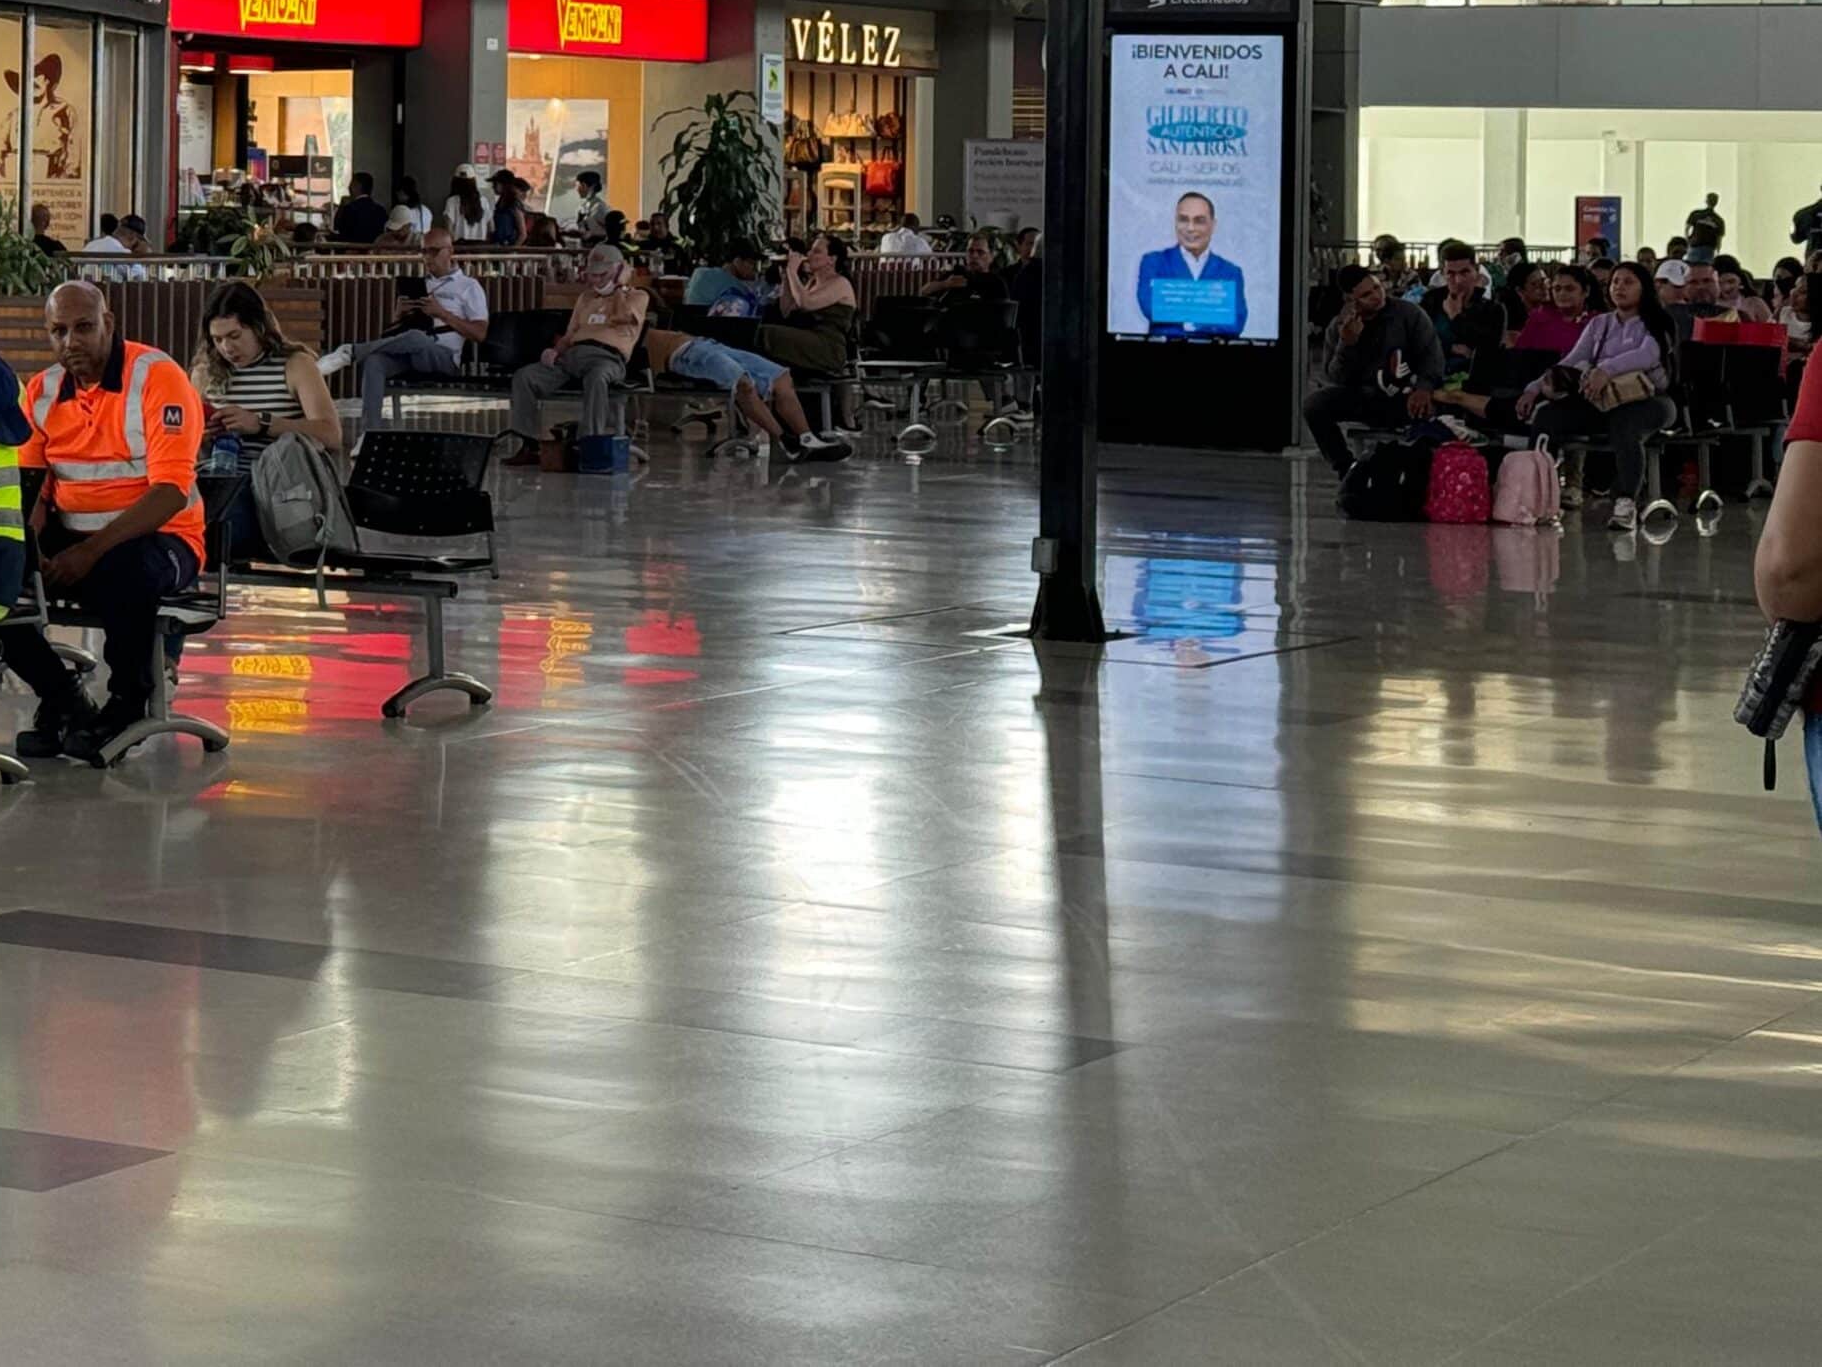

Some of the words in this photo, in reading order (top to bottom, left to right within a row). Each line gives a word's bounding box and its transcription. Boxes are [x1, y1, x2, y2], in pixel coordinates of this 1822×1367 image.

[791, 10, 901, 67] VÉLEZ
[1132, 44, 1263, 60] ¡BIENVENIDOS
[1163, 64, 1177, 79] A
[1182, 64, 1228, 79] CALI!
[165, 408, 180, 424] M
